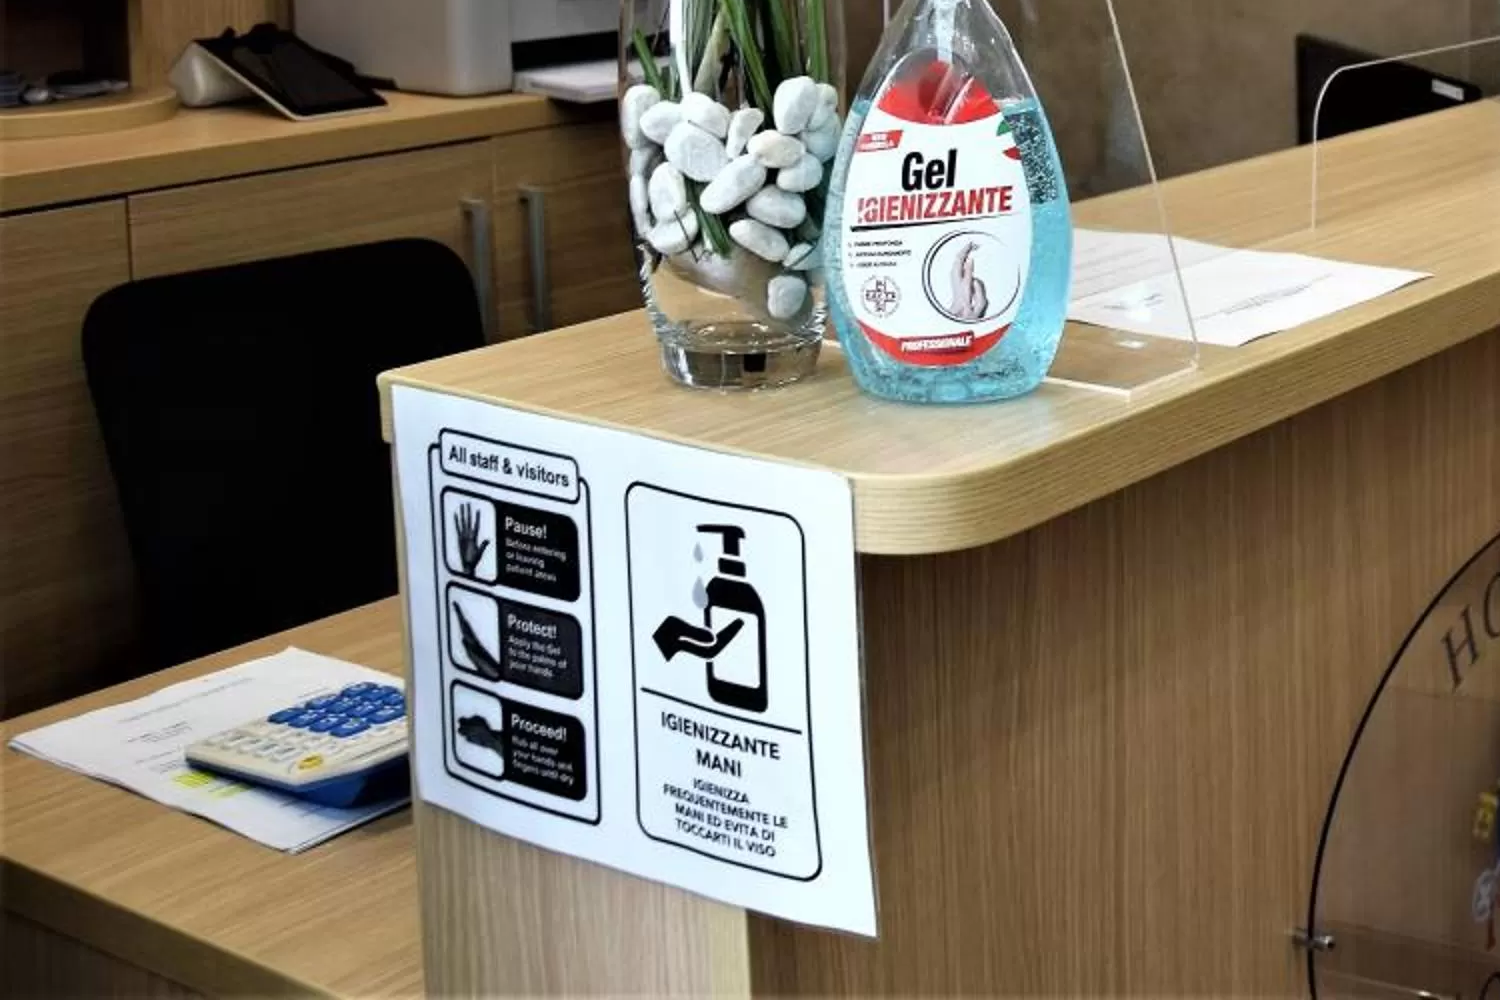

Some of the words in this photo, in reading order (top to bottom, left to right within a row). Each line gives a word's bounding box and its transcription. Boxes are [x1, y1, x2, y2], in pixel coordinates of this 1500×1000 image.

[901, 149, 958, 192] Gel
[857, 185, 1014, 224] IGIENIZZANTE
[449, 445, 467, 464] All
[470, 452, 499, 472] staff
[502, 457, 513, 475] &
[516, 462, 569, 488] visitors
[505, 516, 547, 539] Pause!
[507, 613, 557, 639] Protect!
[511, 713, 567, 743] Proceed!
[661, 711, 781, 761] IGIENIZZANTE
[696, 748, 742, 778] MANI
[663, 783, 770, 825] FREQUENTEMENTE
[773, 815, 788, 829] LE
[693, 777, 751, 804] IGIENIZZA
[675, 802, 704, 822] MANI
[707, 813, 722, 828] ED
[724, 819, 758, 838] EVITA
[761, 829, 775, 842] DI
[675, 817, 730, 848] TOCCARTI
[733, 837, 744, 850] IL
[746, 839, 777, 858] VISO
